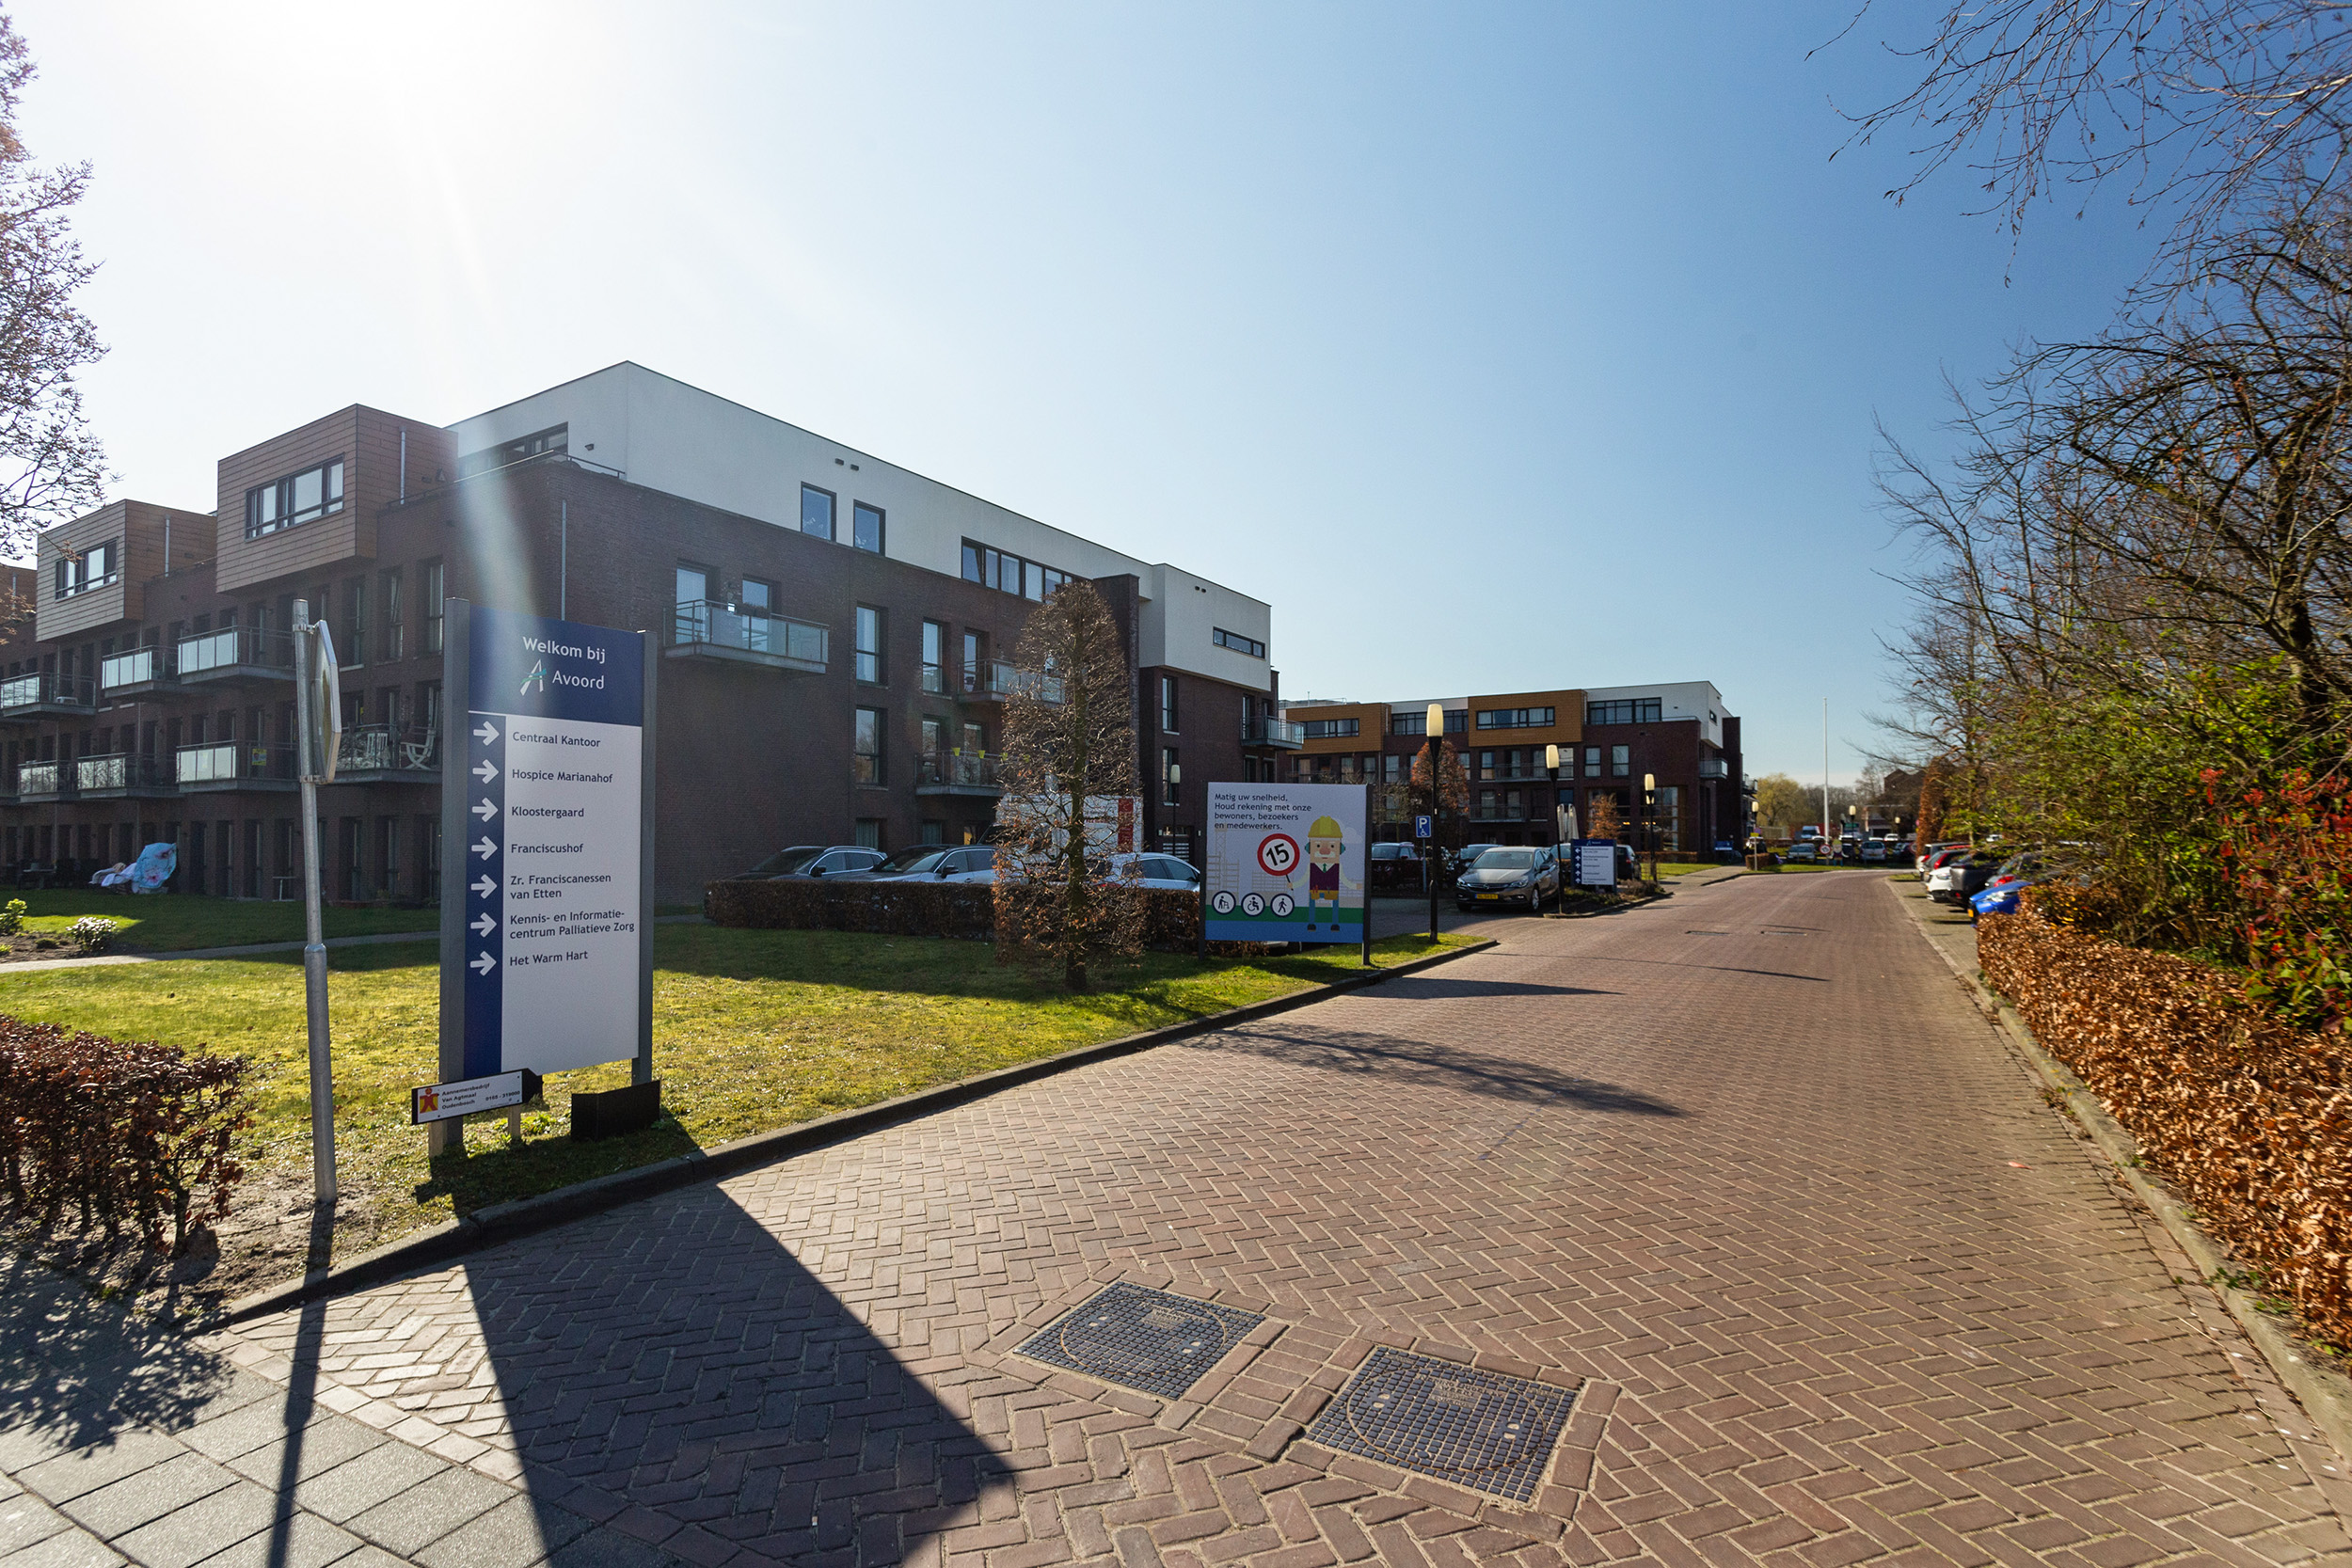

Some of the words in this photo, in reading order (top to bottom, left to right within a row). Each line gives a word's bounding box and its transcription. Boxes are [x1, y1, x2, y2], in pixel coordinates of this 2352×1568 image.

[522, 636, 582, 658] Welkom
[587, 646, 606, 664] bij
[551, 670, 604, 689] Avoord
[512, 731, 558, 745] Centraal
[561, 736, 601, 748] Kantoor
[512, 768, 555, 782] Hospice
[557, 771, 613, 784] Marianahof
[1215, 793, 1236, 801] Matig
[511, 806, 585, 819] Kloostergaard
[1237, 803, 1273, 813] rekening
[1214, 813, 1256, 821] bewoners,
[1258, 813, 1299, 821] bezoekers
[1419, 817, 1428, 830] P
[1227, 821, 1283, 831] medewerkers.
[511, 843, 584, 854] Franciscushof
[1265, 842, 1290, 867] 15
[510, 876, 525, 885] Zr.
[529, 874, 612, 885] Franciscanessen
[510, 891, 530, 900] van
[533, 889, 563, 899] Etten
[510, 913, 550, 925] Kennis-
[553, 913, 566, 923] en
[569, 909, 626, 921] Informatie-
[509, 927, 556, 940] centrum
[559, 924, 612, 936] Palliatieve
[613, 922, 635, 933] Zorg
[510, 956, 530, 967] Het
[532, 953, 564, 964] Warm
[565, 950, 589, 961] Hart
[453, 1092, 477, 1101] Agtmaal
